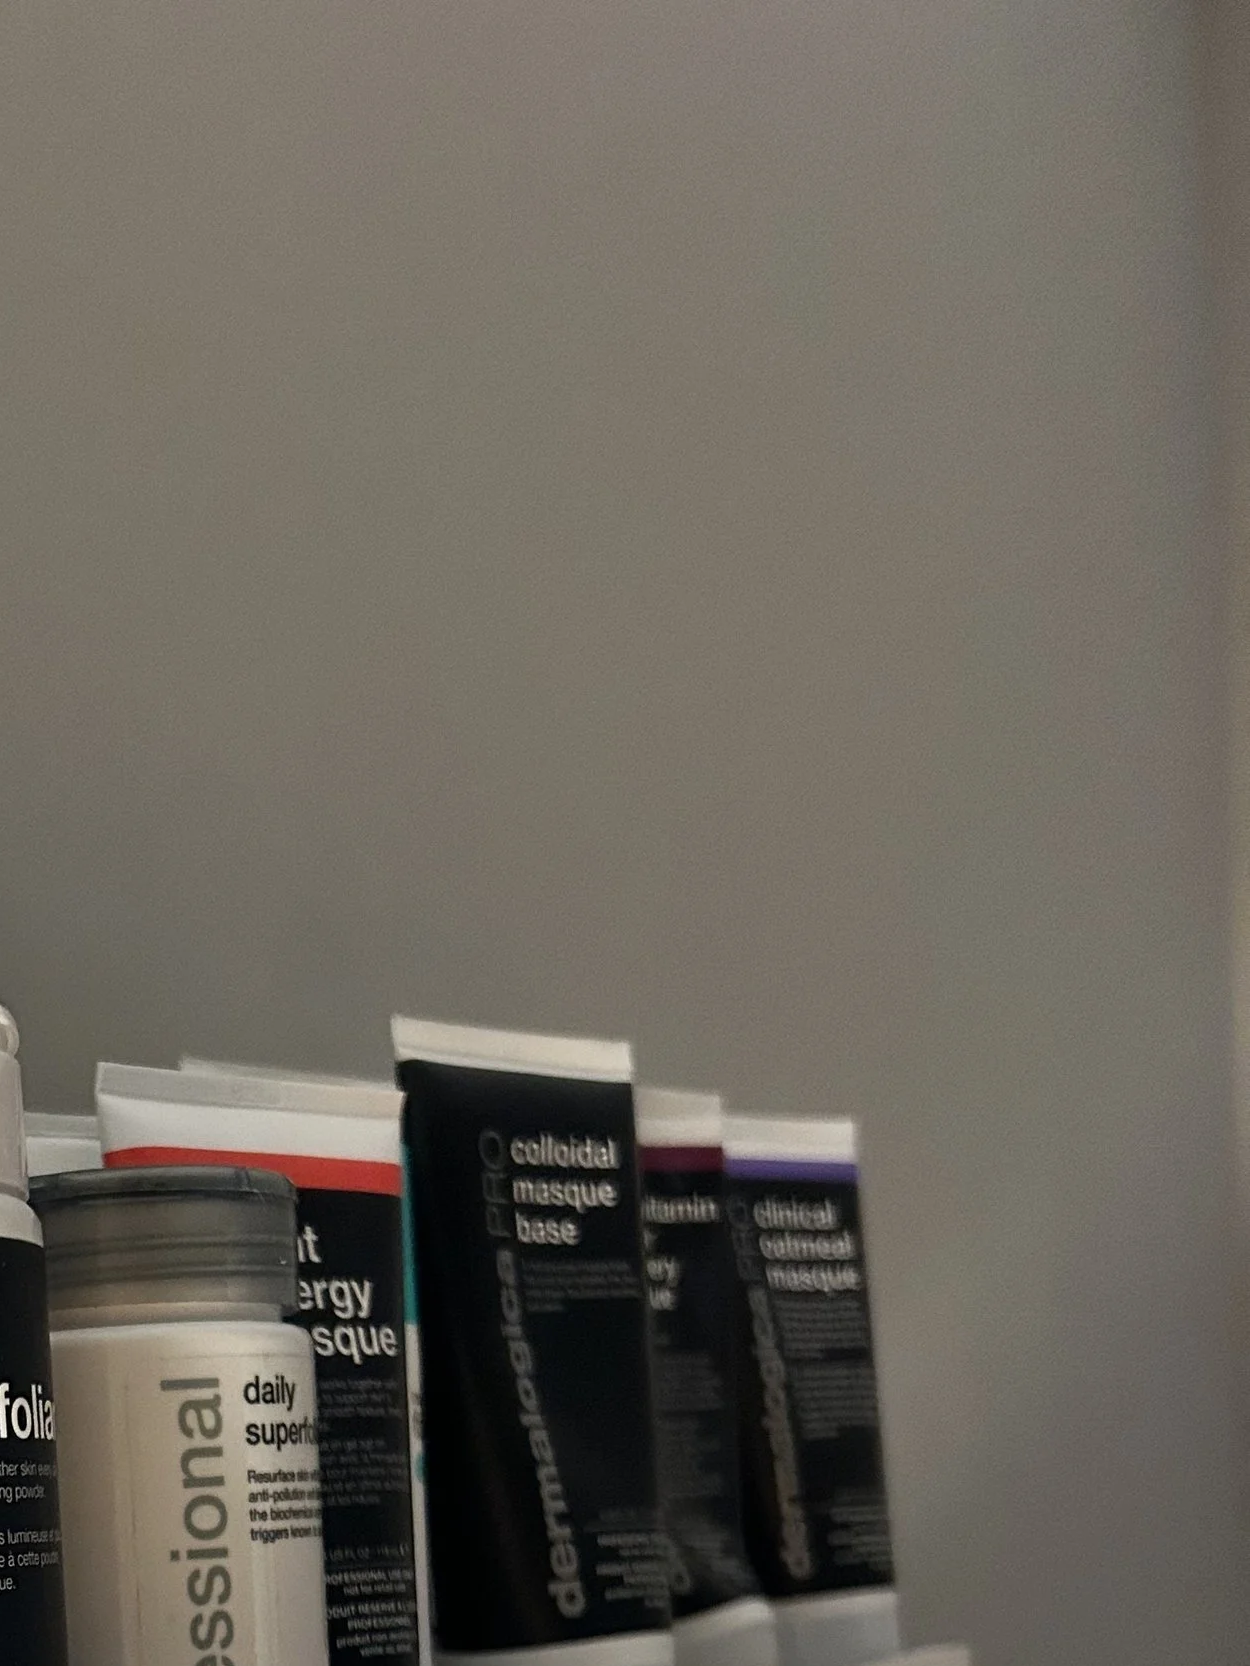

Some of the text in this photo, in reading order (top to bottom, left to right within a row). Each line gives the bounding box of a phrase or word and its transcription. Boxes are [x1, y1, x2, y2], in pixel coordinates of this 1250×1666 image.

[510, 1133, 621, 1170] colloidal
[512, 1176, 618, 1213] masque
[516, 1209, 581, 1245] base
[243, 1374, 296, 1412] daily
[249, 1508, 268, 1522] the
[8, 1550, 16, 1568] à
[17, 1551, 40, 1567] cette
